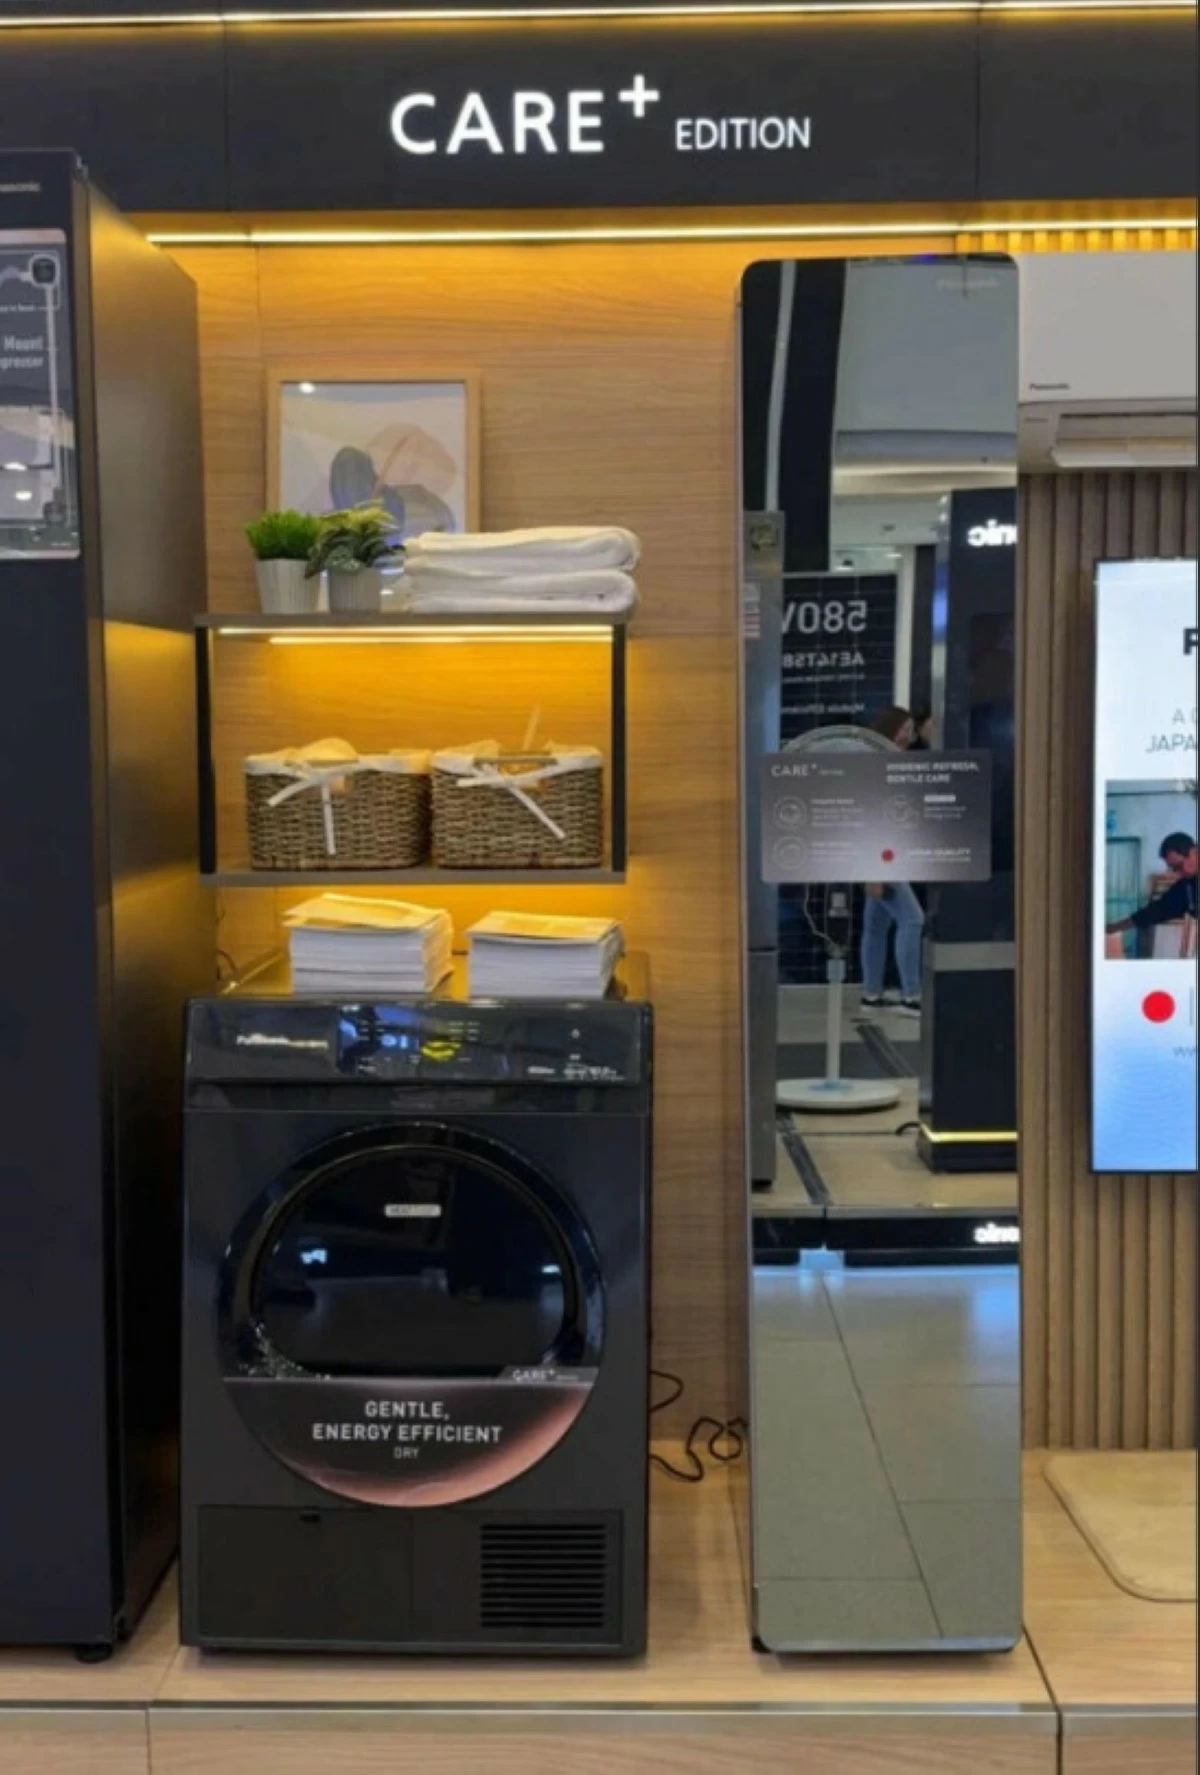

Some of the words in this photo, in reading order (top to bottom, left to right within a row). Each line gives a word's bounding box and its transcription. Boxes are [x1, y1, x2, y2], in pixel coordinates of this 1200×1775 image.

[674, 117, 812, 151] EDITION
[365, 1400, 450, 1421] GENTLE,
[312, 1422, 393, 1441] ENERGY
[397, 1424, 503, 1444] EFFICIENT
